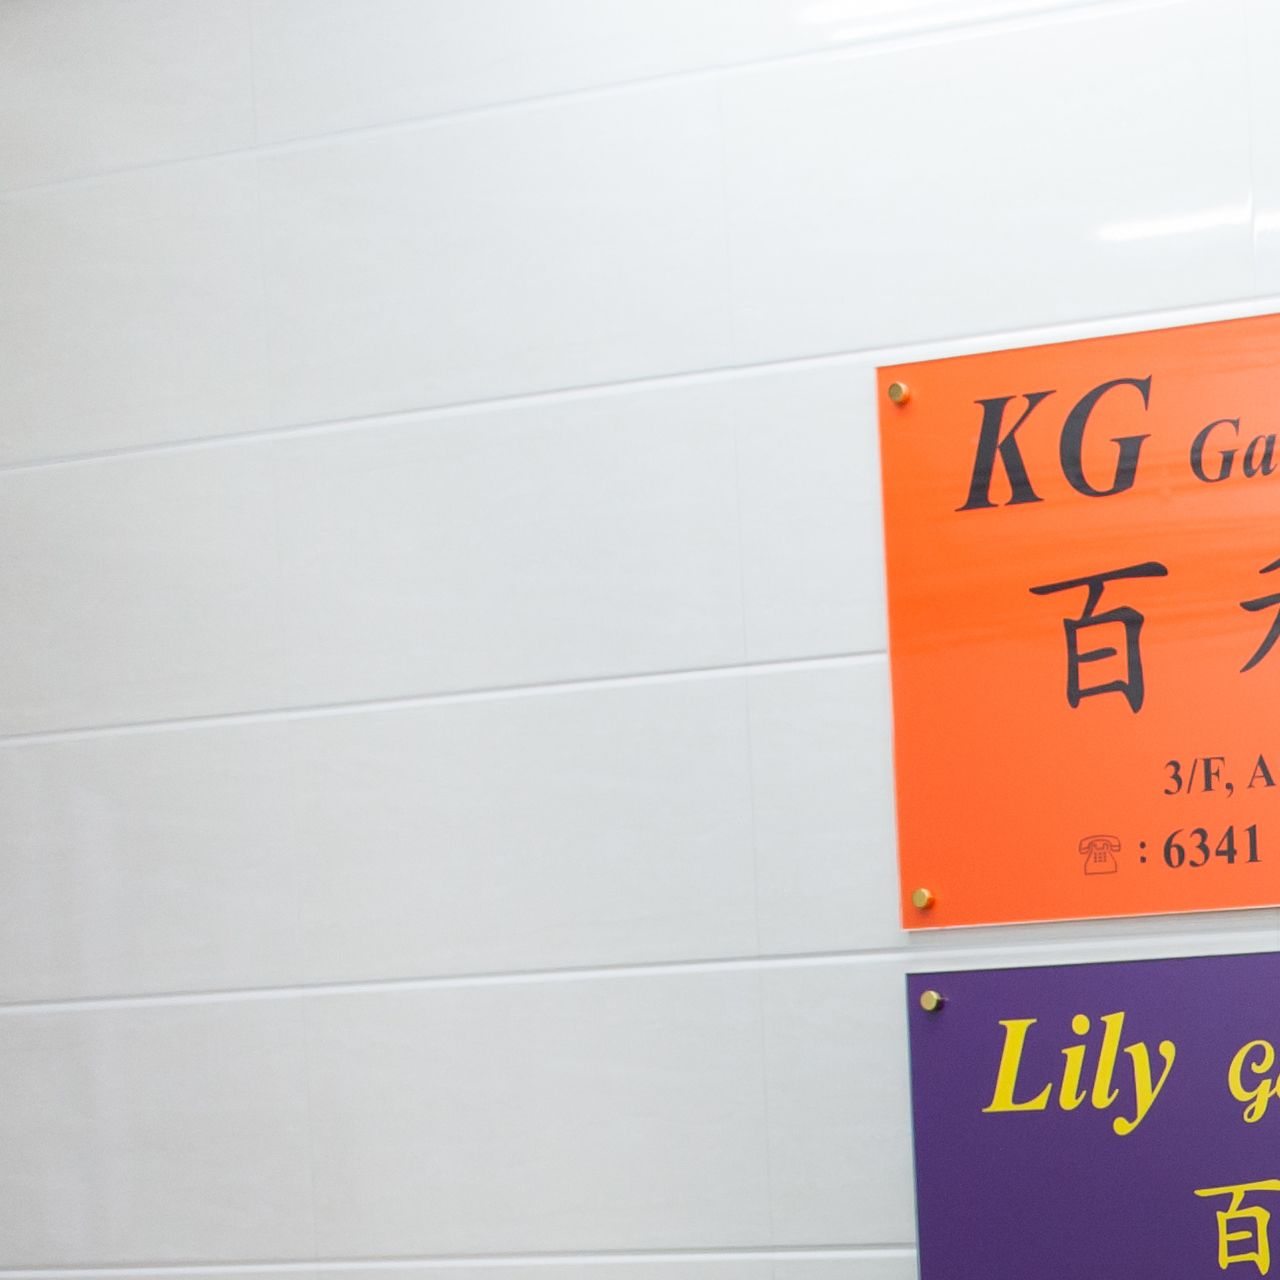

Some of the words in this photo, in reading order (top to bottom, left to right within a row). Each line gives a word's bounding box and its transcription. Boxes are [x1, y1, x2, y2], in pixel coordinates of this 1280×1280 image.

[954, 375, 1152, 512] KG
[1164, 756, 1234, 796] 3/F,
[1163, 824, 1260, 869] 6341
[981, 1011, 1177, 1136] Lily
